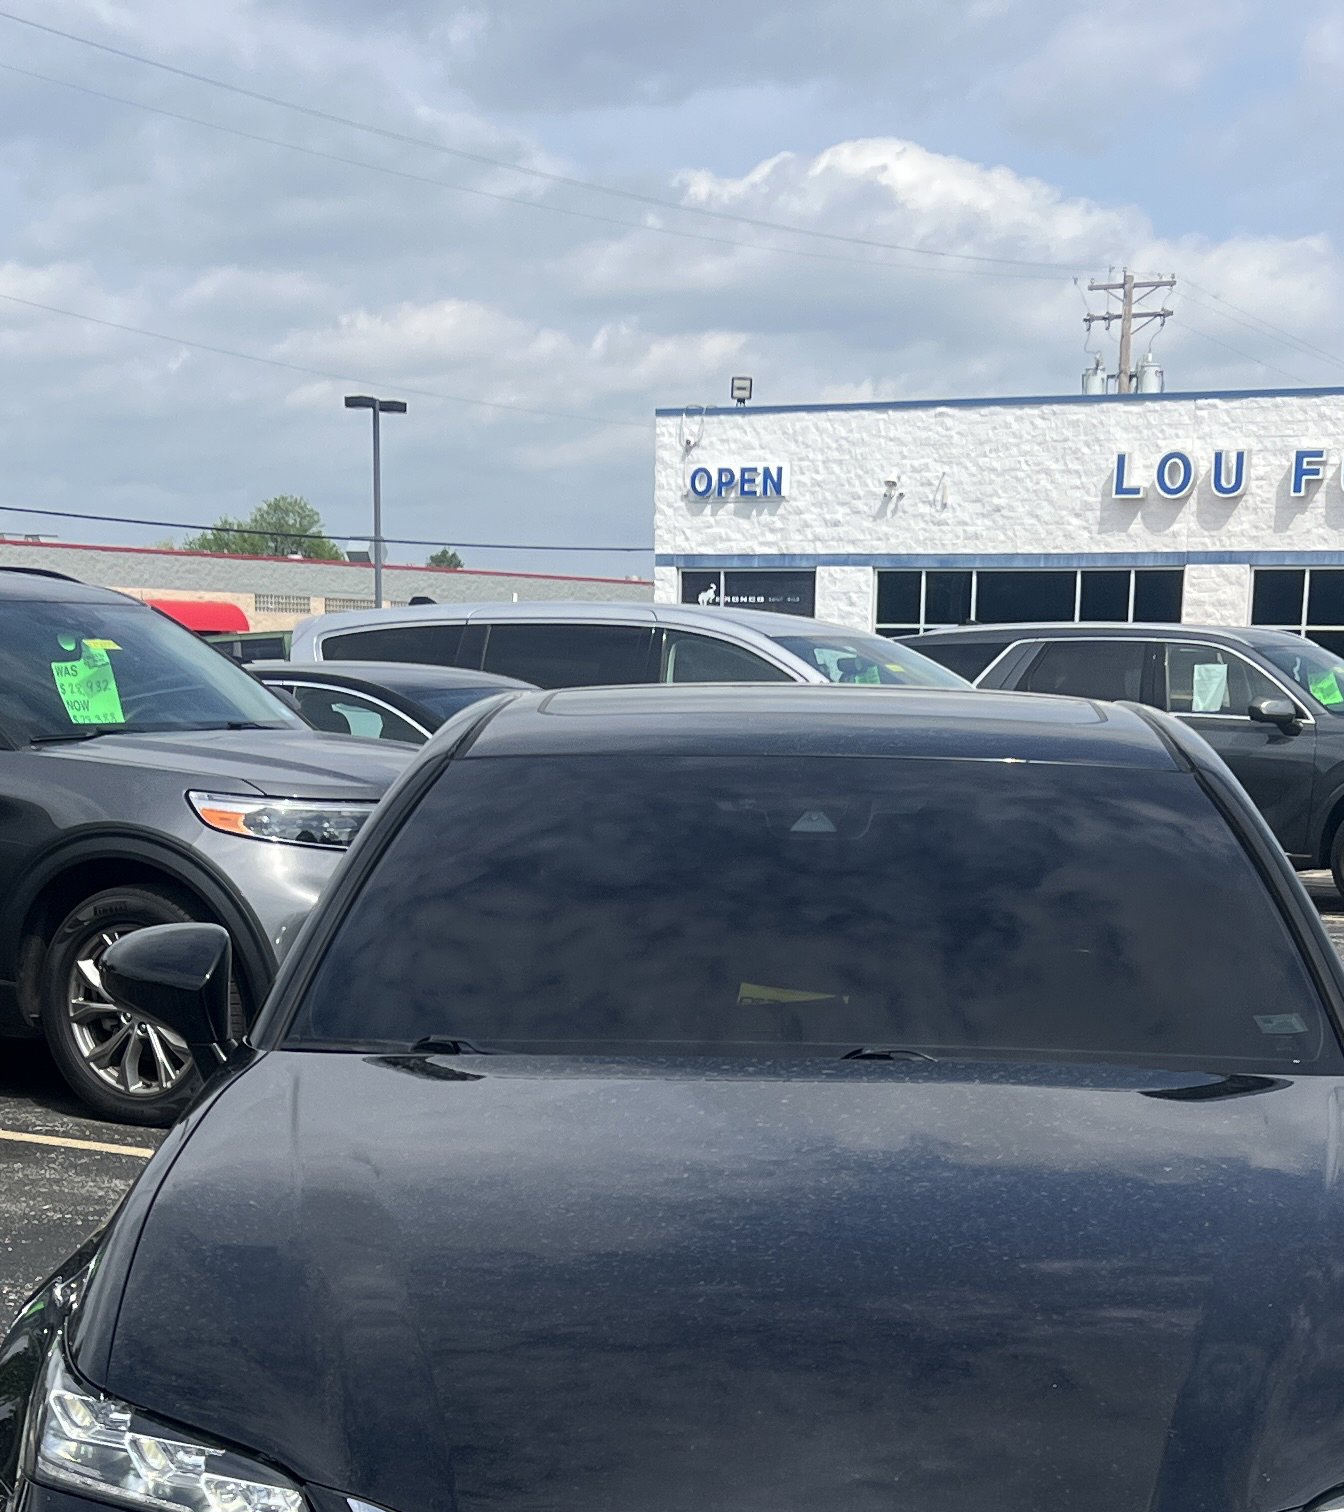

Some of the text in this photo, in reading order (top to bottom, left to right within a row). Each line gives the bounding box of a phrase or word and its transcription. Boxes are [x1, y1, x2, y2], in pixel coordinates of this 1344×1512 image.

[690, 466, 783, 497] OPEN
[1113, 450, 1246, 497] LOU
[55, 664, 79, 677] WAS
[66, 700, 90, 712] NOW
